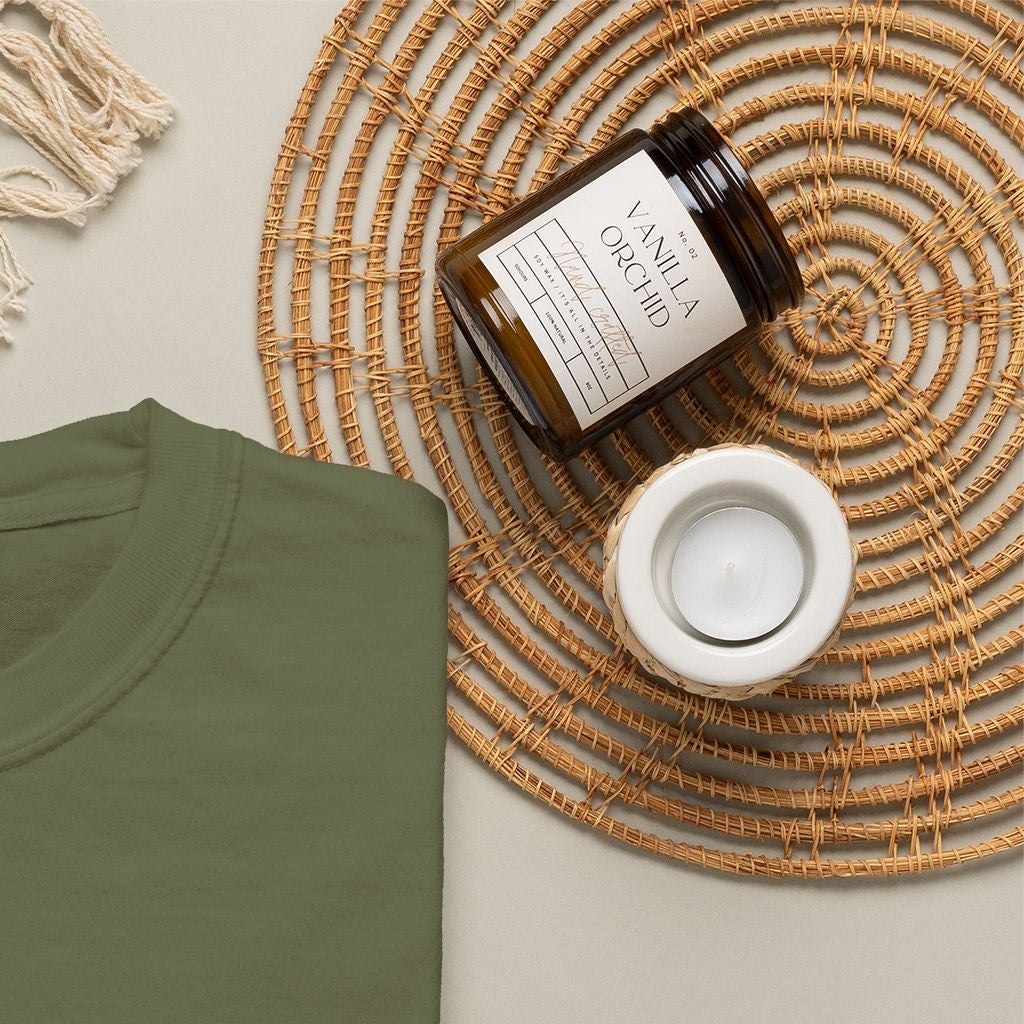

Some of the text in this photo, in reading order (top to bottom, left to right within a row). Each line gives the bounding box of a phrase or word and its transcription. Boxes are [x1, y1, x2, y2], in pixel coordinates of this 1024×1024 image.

[601, 226, 670, 328] ORCHID
[627, 200, 700, 319] VANILLA
[678, 231, 698, 259] No. 02
[534, 255, 544, 266] SOY
[544, 268, 555, 283] WAX
[558, 291, 569, 306] IT'S
[569, 309, 578, 322] ALL
[578, 322, 586, 333] IN
[585, 336, 595, 350] THE
[594, 352, 612, 380] DETAILS
